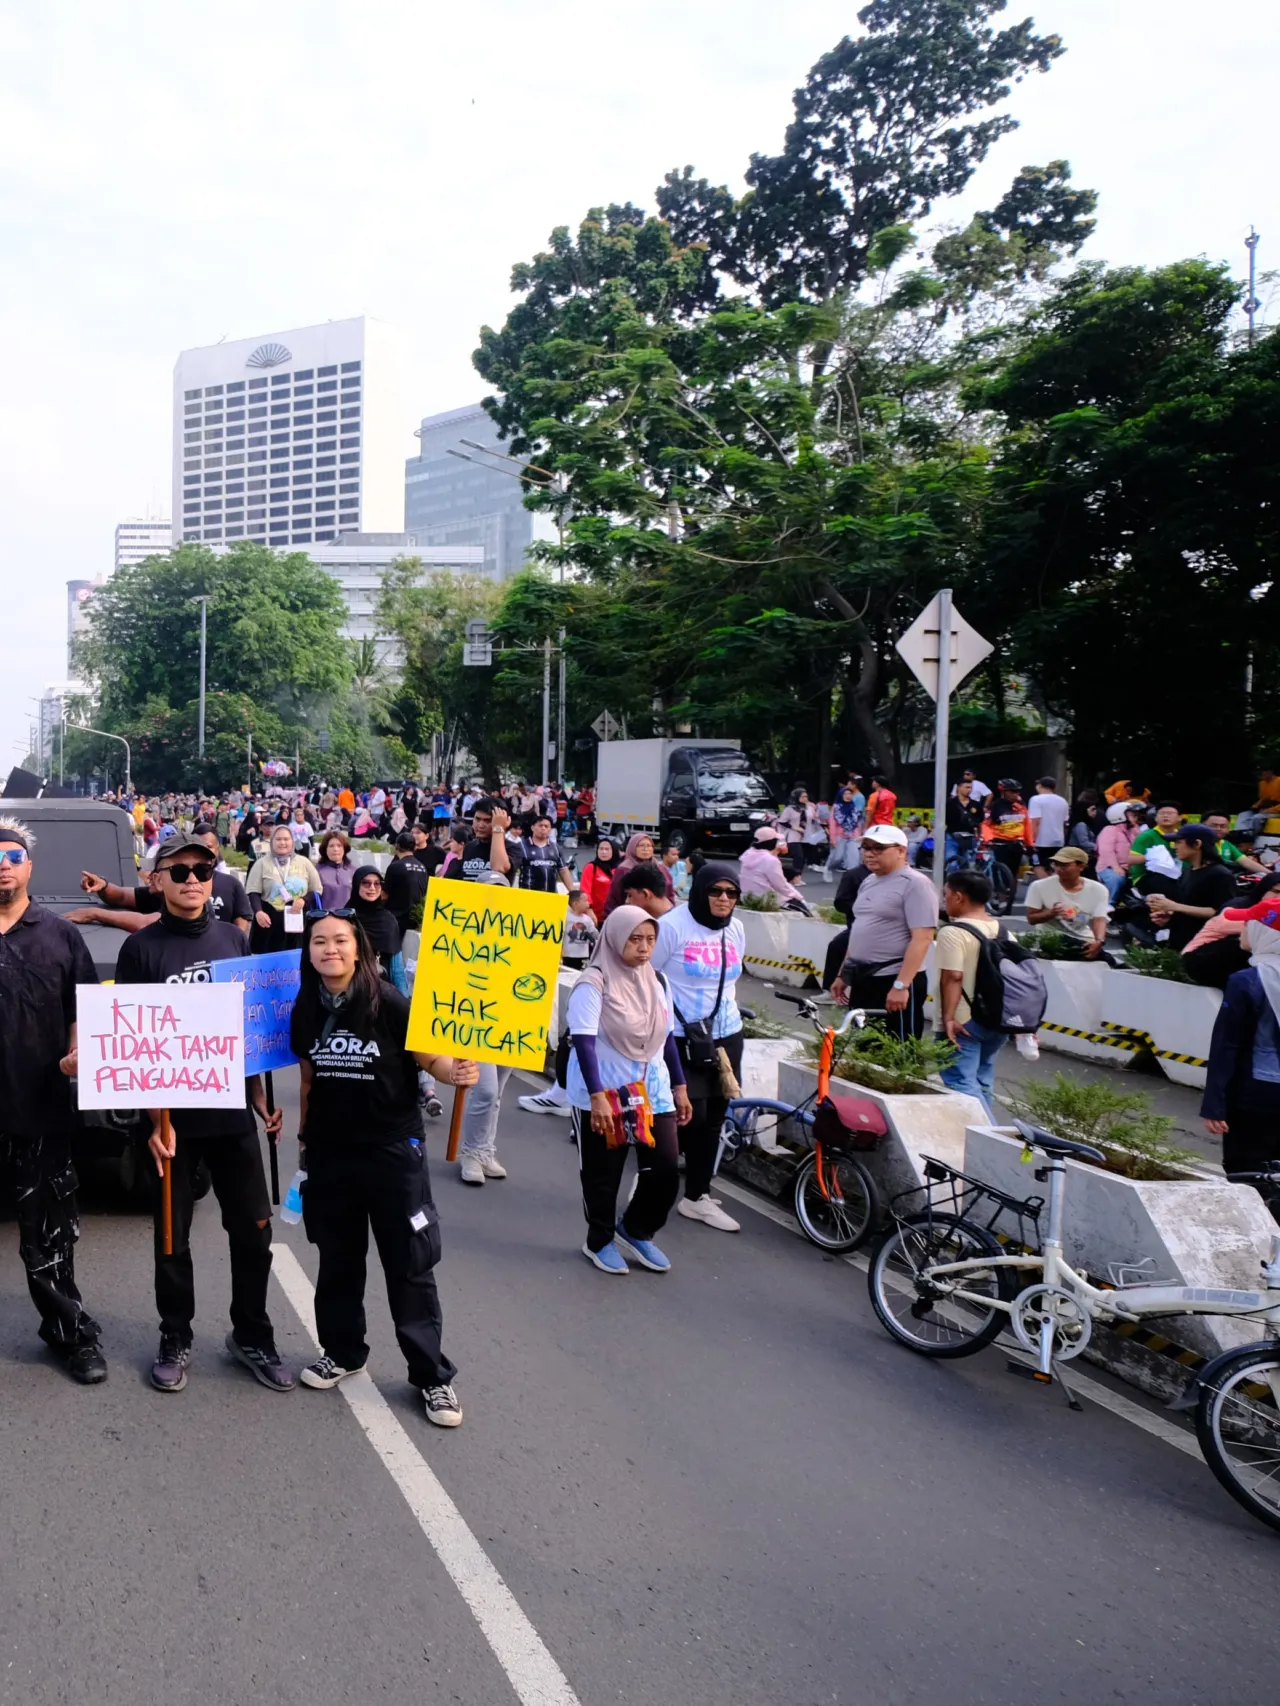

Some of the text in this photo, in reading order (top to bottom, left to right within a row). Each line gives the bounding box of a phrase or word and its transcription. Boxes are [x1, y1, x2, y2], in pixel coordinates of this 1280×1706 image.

[433, 899, 564, 944] KEAMANAN
[432, 933, 511, 967] ANAK
[111, 998, 181, 1035] KITA
[433, 990, 499, 1022] HAK
[91, 1033, 238, 1064] TIDAK TAKUT
[94, 1065, 231, 1093] PENGUASA!
